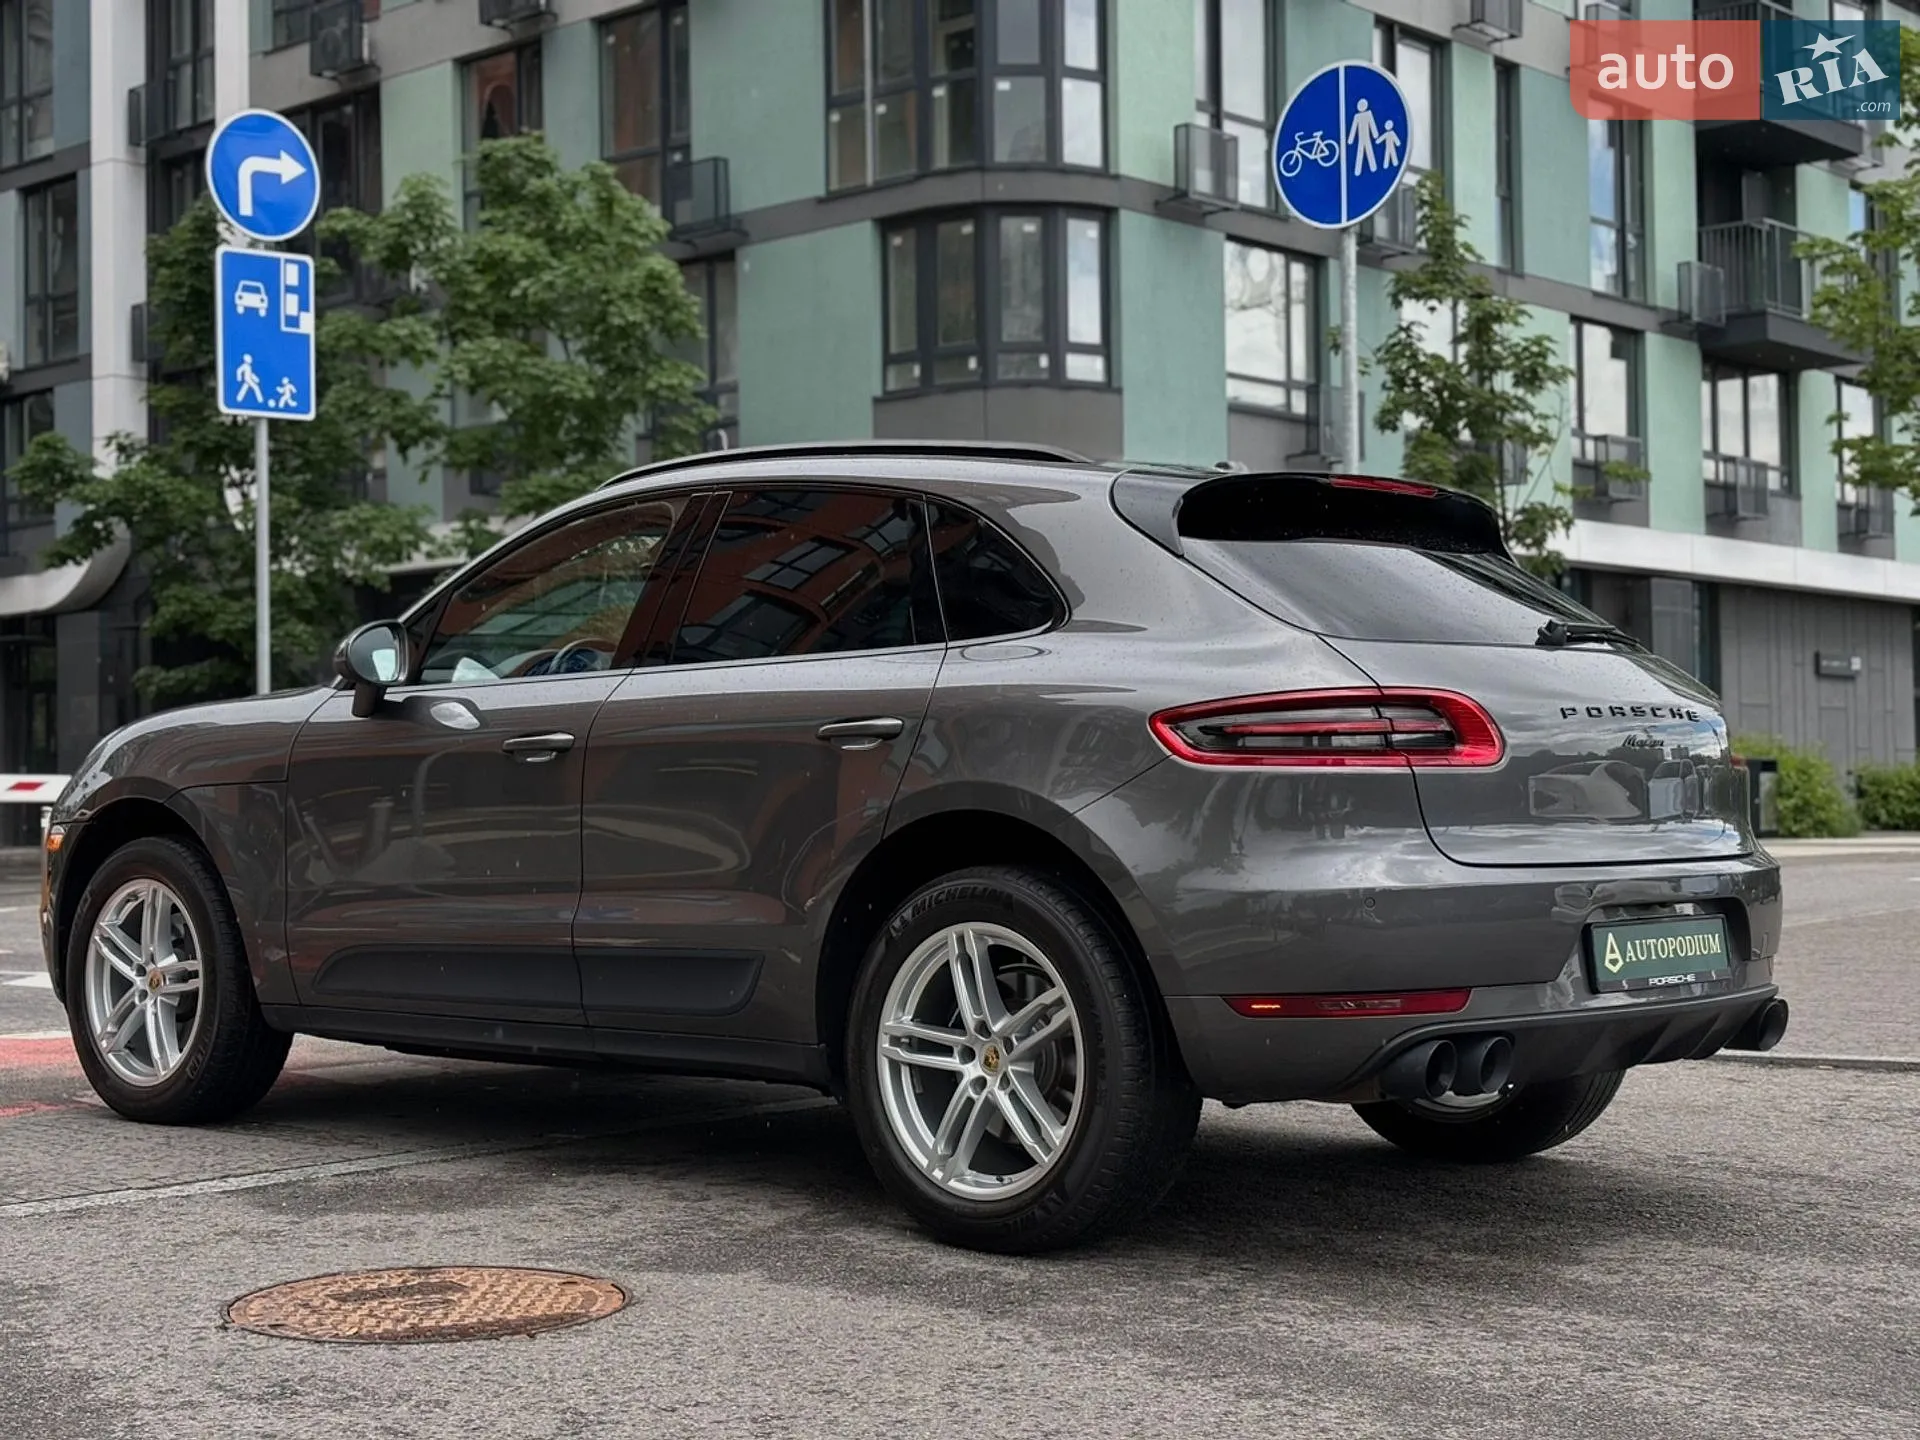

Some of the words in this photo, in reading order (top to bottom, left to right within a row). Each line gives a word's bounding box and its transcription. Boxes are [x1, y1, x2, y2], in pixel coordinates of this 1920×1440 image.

[1560, 705, 1700, 722] PORSCHE
[1626, 933, 1721, 962] AUTOPODIUM
[1648, 973, 1696, 986] PORSCHE
